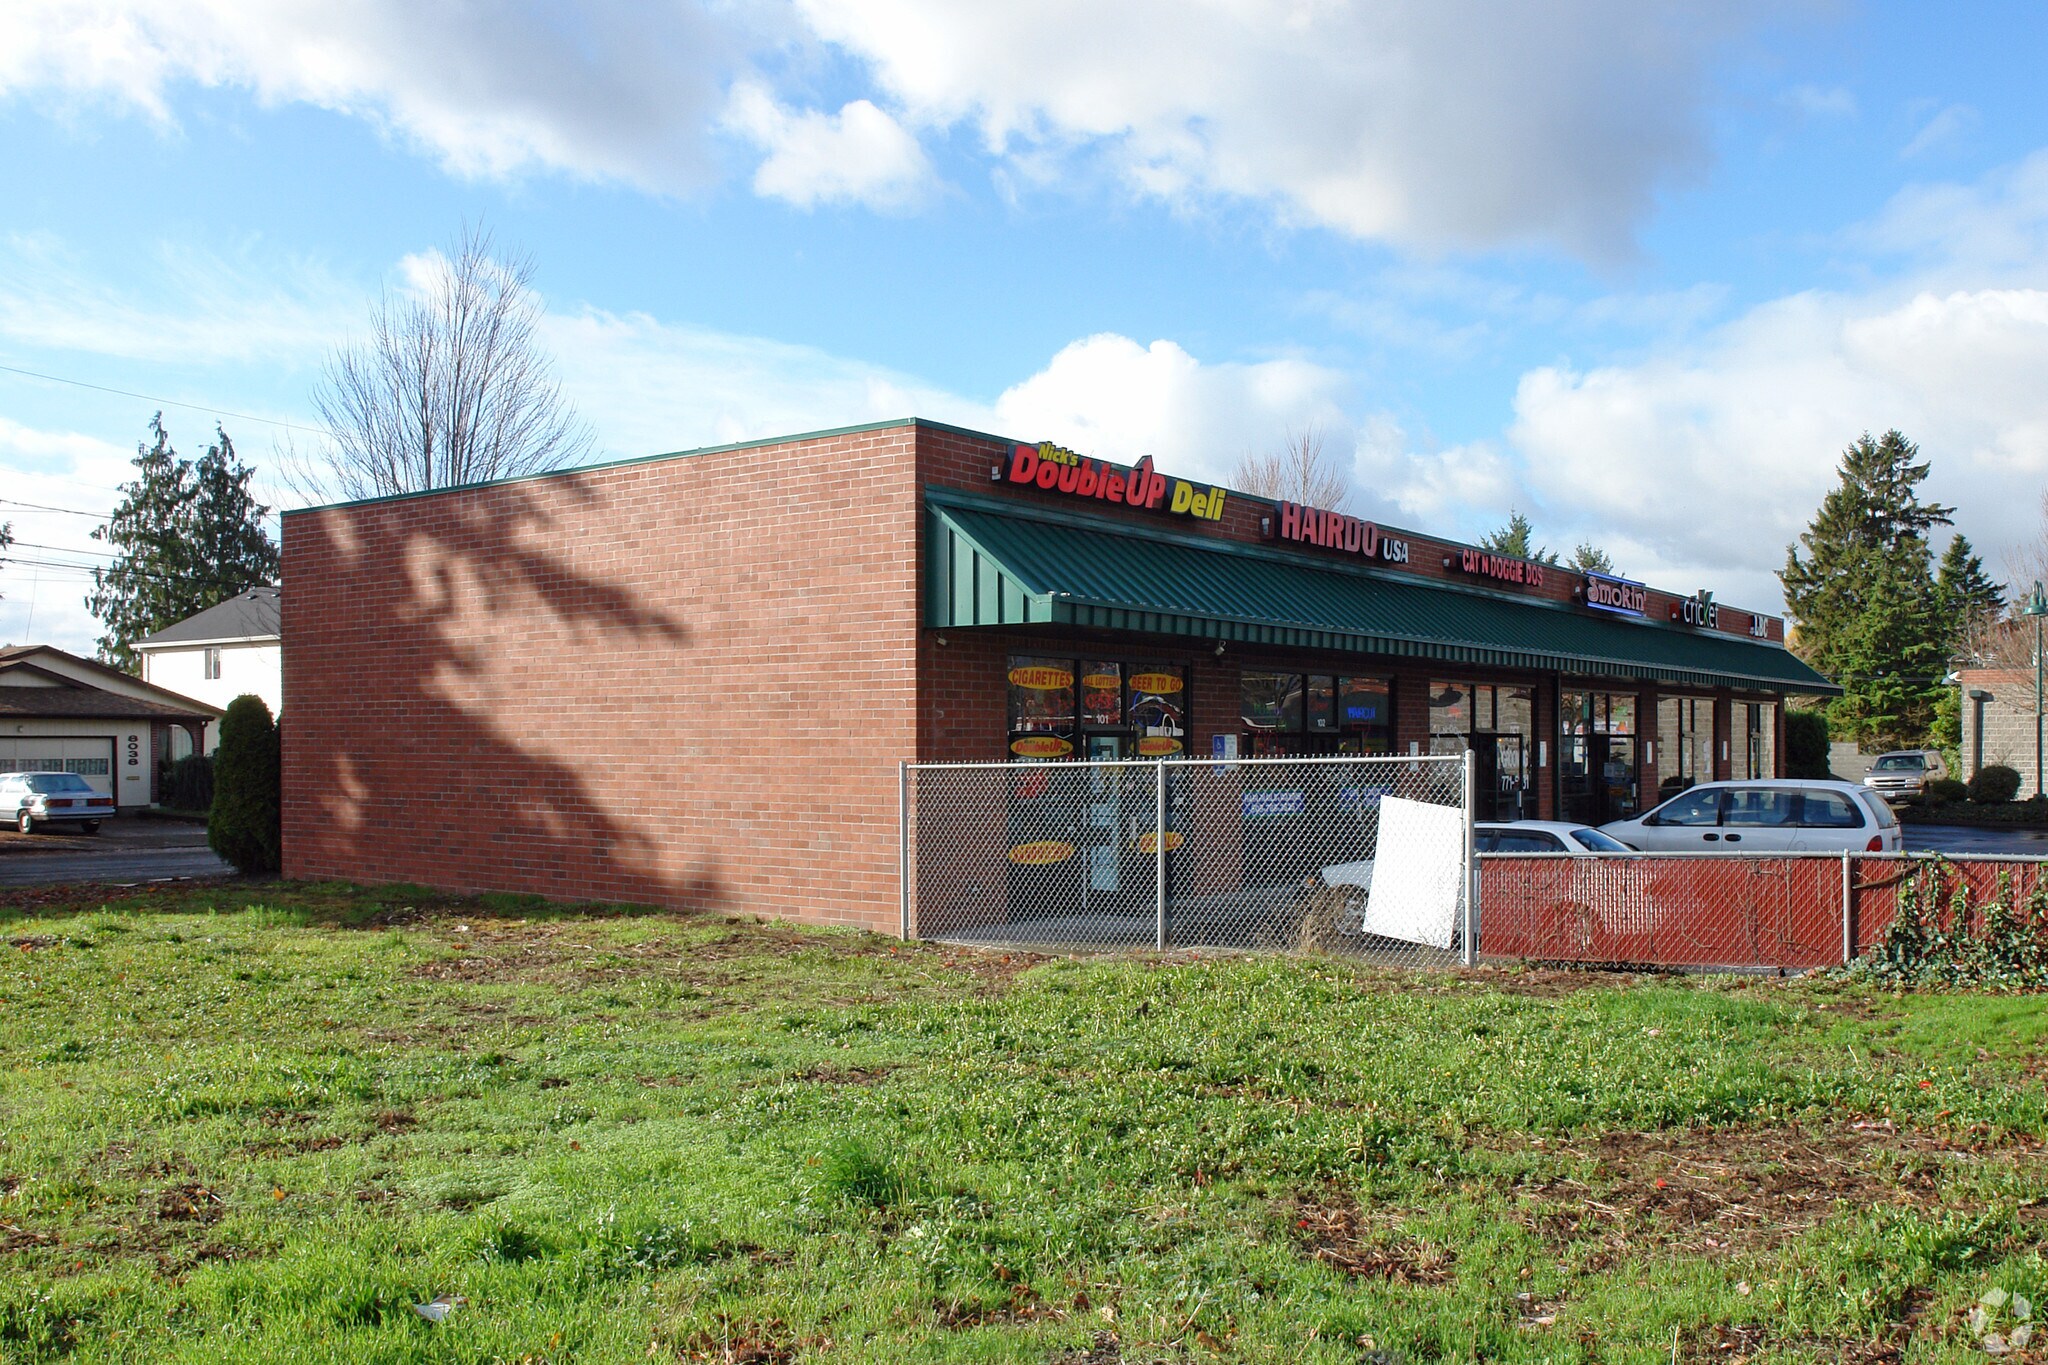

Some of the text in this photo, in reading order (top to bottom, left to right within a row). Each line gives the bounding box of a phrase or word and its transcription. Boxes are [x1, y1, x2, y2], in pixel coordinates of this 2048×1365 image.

[1038, 442, 1079, 467] Nick's
[1171, 481, 1226, 521] Deli
[1281, 501, 1409, 563] HAIRDO USA
[1462, 549, 1480, 574] CAT
[1490, 556, 1523, 583] DOGGIE
[1525, 563, 1543, 587] DOS
[1587, 575, 1647, 611] Smokin'
[1684, 589, 1719, 629] cricket
[1012, 669, 1072, 687] CIGARETTES
[1084, 676, 1120, 687] ALL LOTTERY
[1132, 675, 1182, 692] BEER TO GO
[1097, 714, 1109, 724] 101
[1317, 718, 1326, 727] 102
[128, 735, 139, 766] 8038
